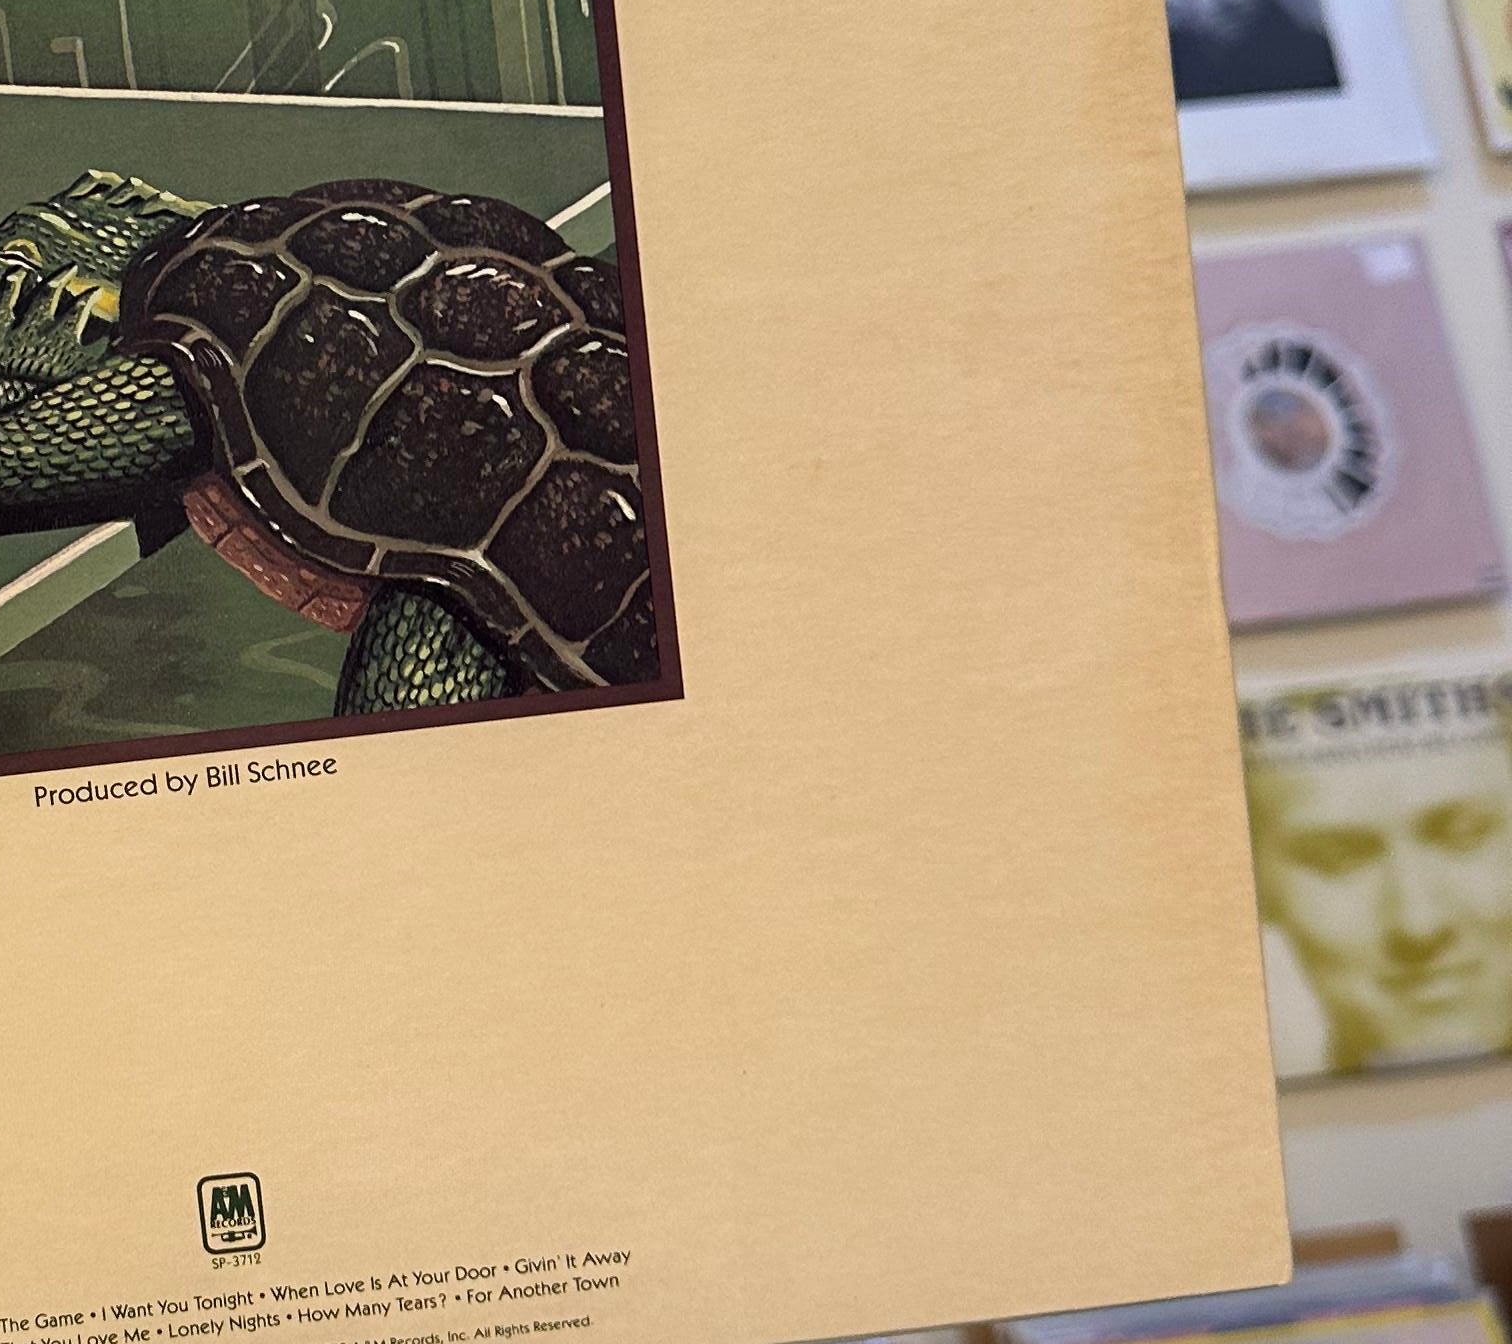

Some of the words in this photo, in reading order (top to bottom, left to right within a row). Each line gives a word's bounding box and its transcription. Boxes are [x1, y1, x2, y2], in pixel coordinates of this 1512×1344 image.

[34, 773, 158, 808] Produced
[165, 771, 199, 796] by
[206, 763, 241, 788] Bill
[247, 758, 338, 784] Schnee
[209, 1216, 257, 1229] RECORDS
[211, 1252, 262, 1270] SP-3712
[34, 1312, 85, 1329] Game
[101, 1306, 107, 1322] I
[110, 1302, 154, 1320] Want
[157, 1299, 189, 1316] You
[193, 1291, 254, 1311] Tonight
[269, 1285, 320, 1302] When
[324, 1280, 365, 1297] Love
[370, 1276, 383, 1291] Is
[387, 1274, 409, 1289] At
[411, 1270, 450, 1286] Your
[455, 1265, 497, 1281] Door
[514, 1255, 561, 1275] Givin'
[565, 1254, 577, 1269] It
[582, 1250, 631, 1267] Away
[124, 1327, 150, 1344] Me
[168, 1319, 224, 1339] Lonely
[229, 1313, 281, 1333] Nights
[297, 1307, 340, 1324] How
[345, 1302, 392, 1318] Many
[395, 1292, 447, 1312] Tears?
[466, 1288, 493, 1304] For
[498, 1281, 568, 1301] Another
[572, 1275, 620, 1292] Town
[446, 1329, 470, 1344] Inc.
[473, 1327, 491, 1340] All
[494, 1323, 531, 1339] Rights
[533, 1315, 594, 1333] Reserved.
